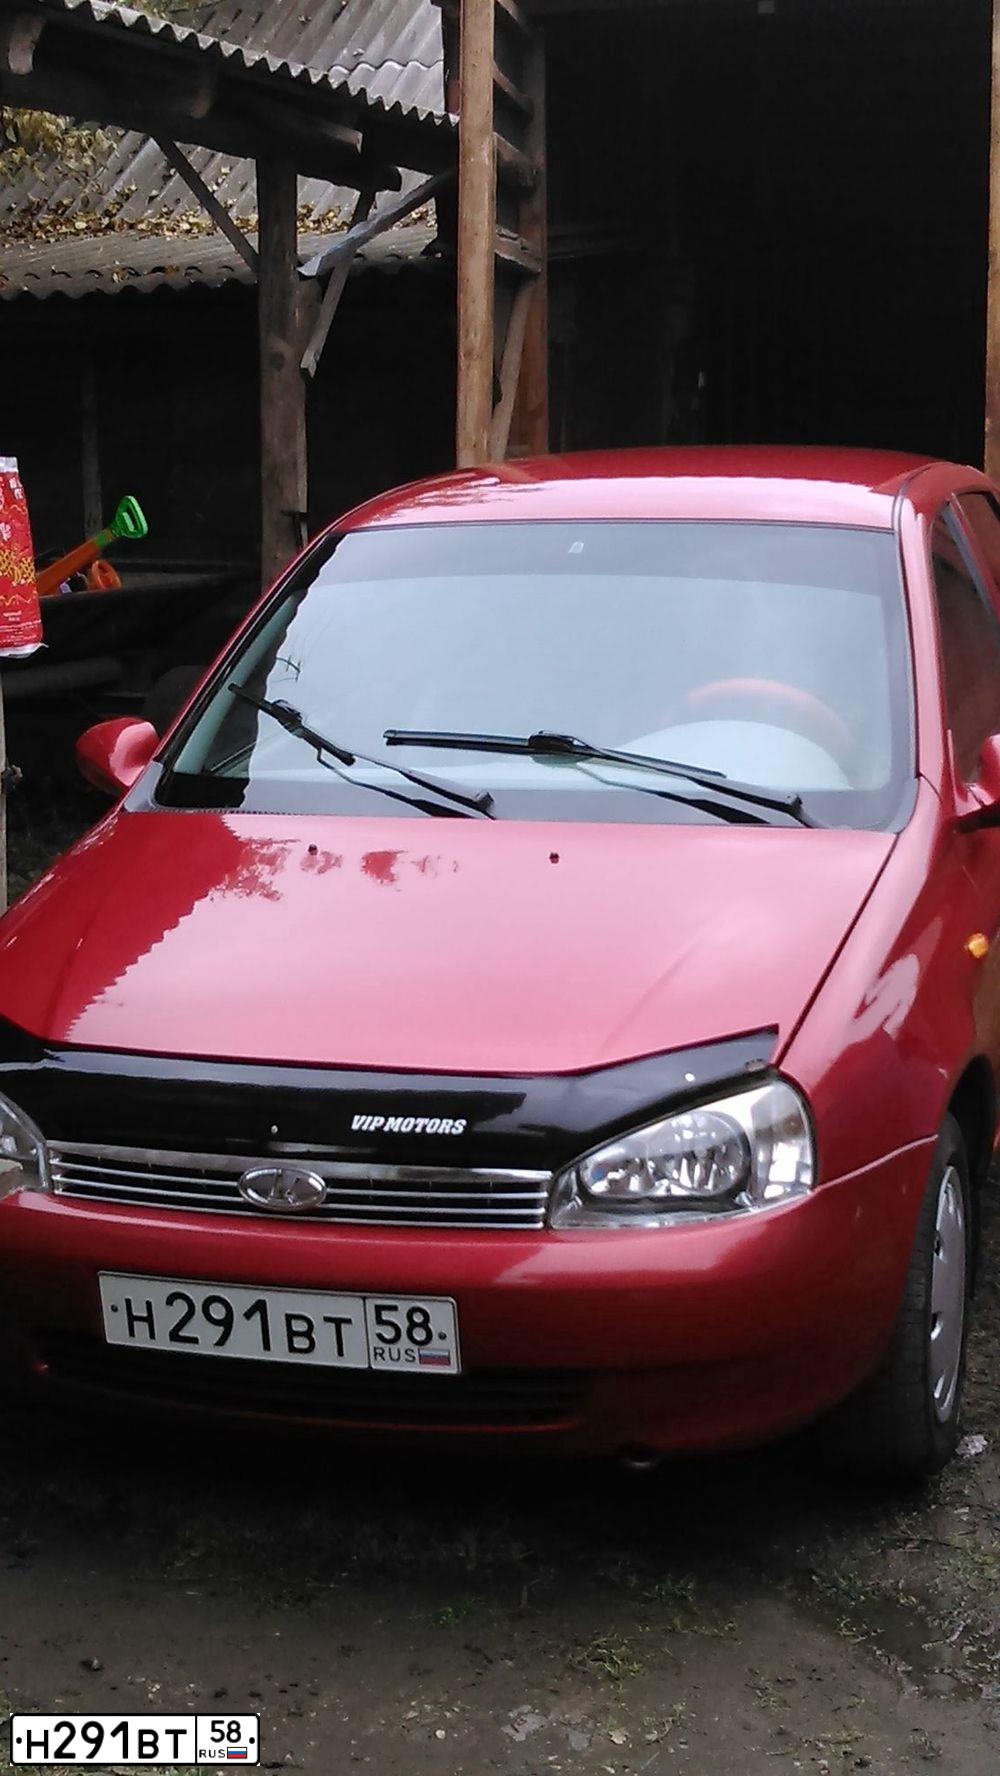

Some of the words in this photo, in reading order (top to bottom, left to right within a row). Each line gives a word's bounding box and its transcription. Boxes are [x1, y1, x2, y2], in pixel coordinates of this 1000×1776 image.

[351, 1115, 385, 1131] VIP
[383, 1117, 467, 1135] MOTORS
[374, 1304, 433, 1346] 58
[373, 1346, 416, 1362] RUS
